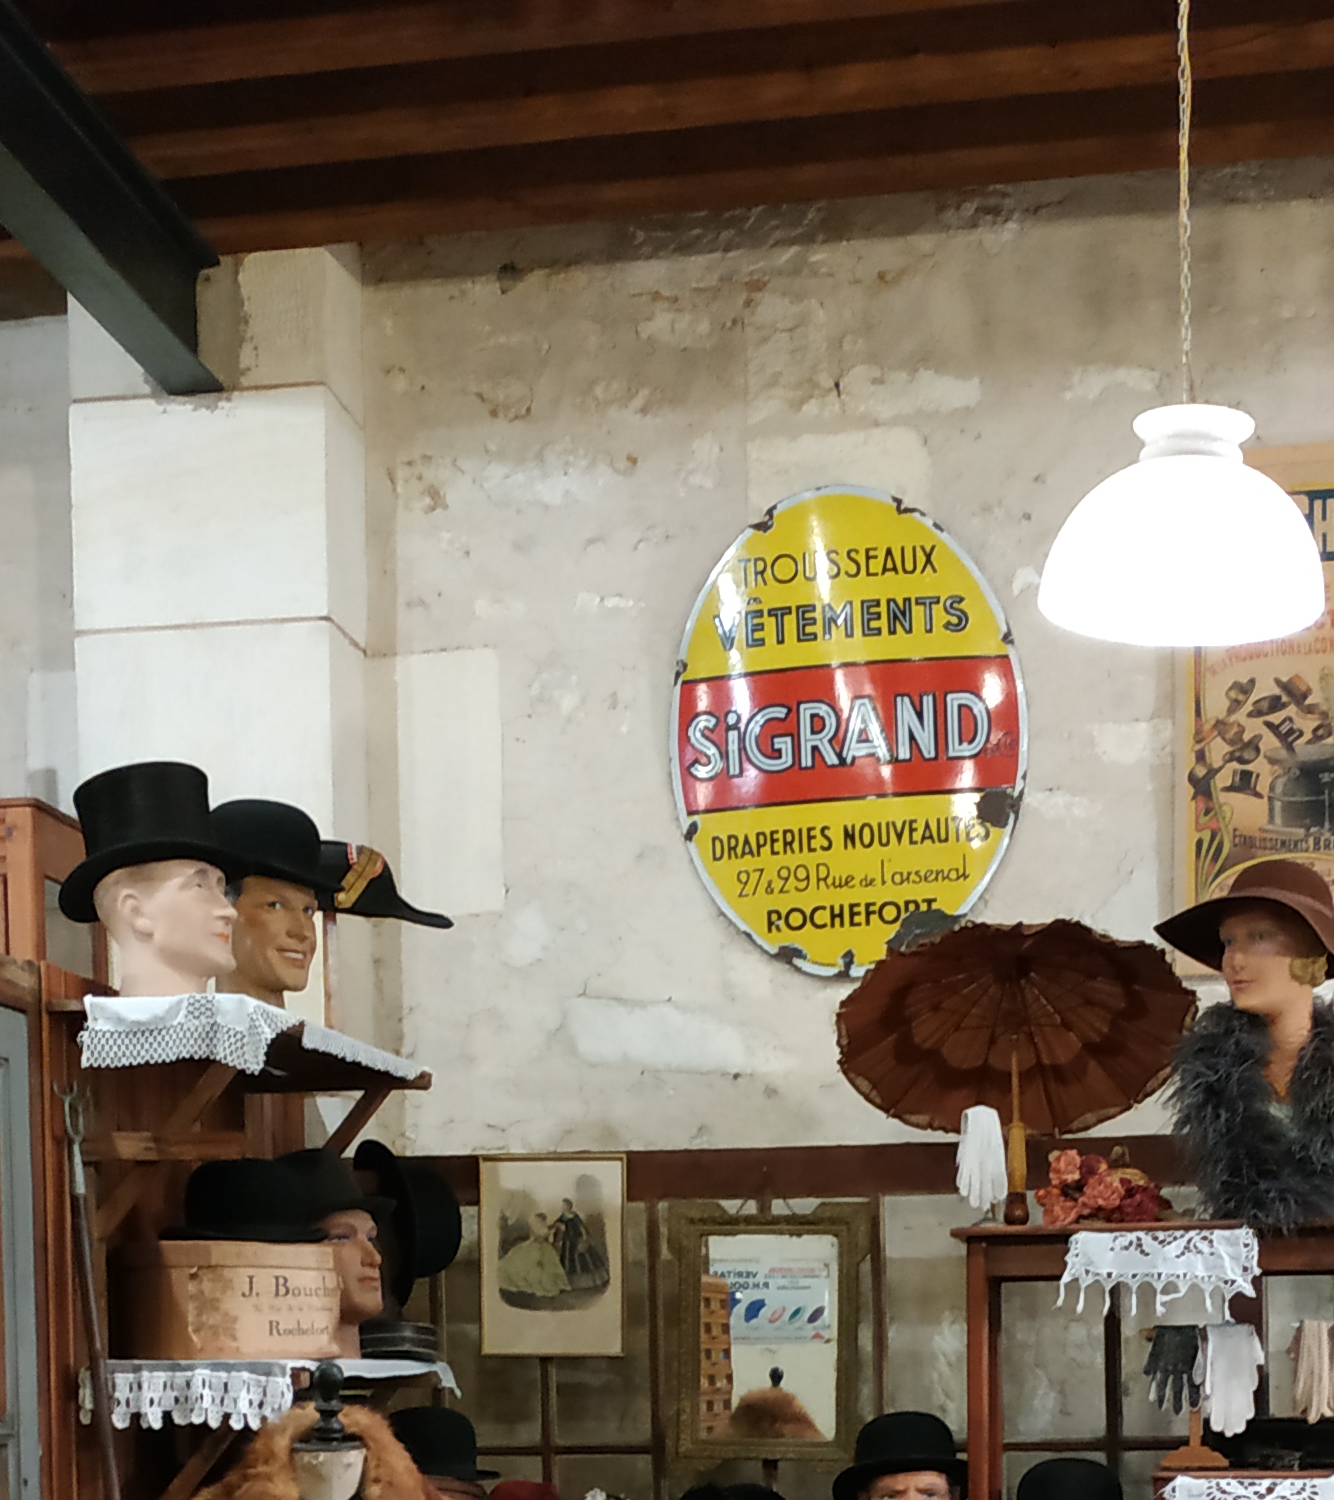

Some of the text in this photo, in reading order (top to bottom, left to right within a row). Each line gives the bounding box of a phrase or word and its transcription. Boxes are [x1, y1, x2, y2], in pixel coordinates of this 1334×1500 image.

[738, 544, 938, 589] TROUSSEAUX
[713, 594, 970, 652] VÊTEMENTS
[710, 825, 834, 862] DRAPERIES
[736, 867, 766, 899] 27
[776, 863, 811, 894] 29
[815, 861, 856, 891] Rue
[859, 873, 877, 888] de
[766, 897, 938, 934] ROCHEFORT
